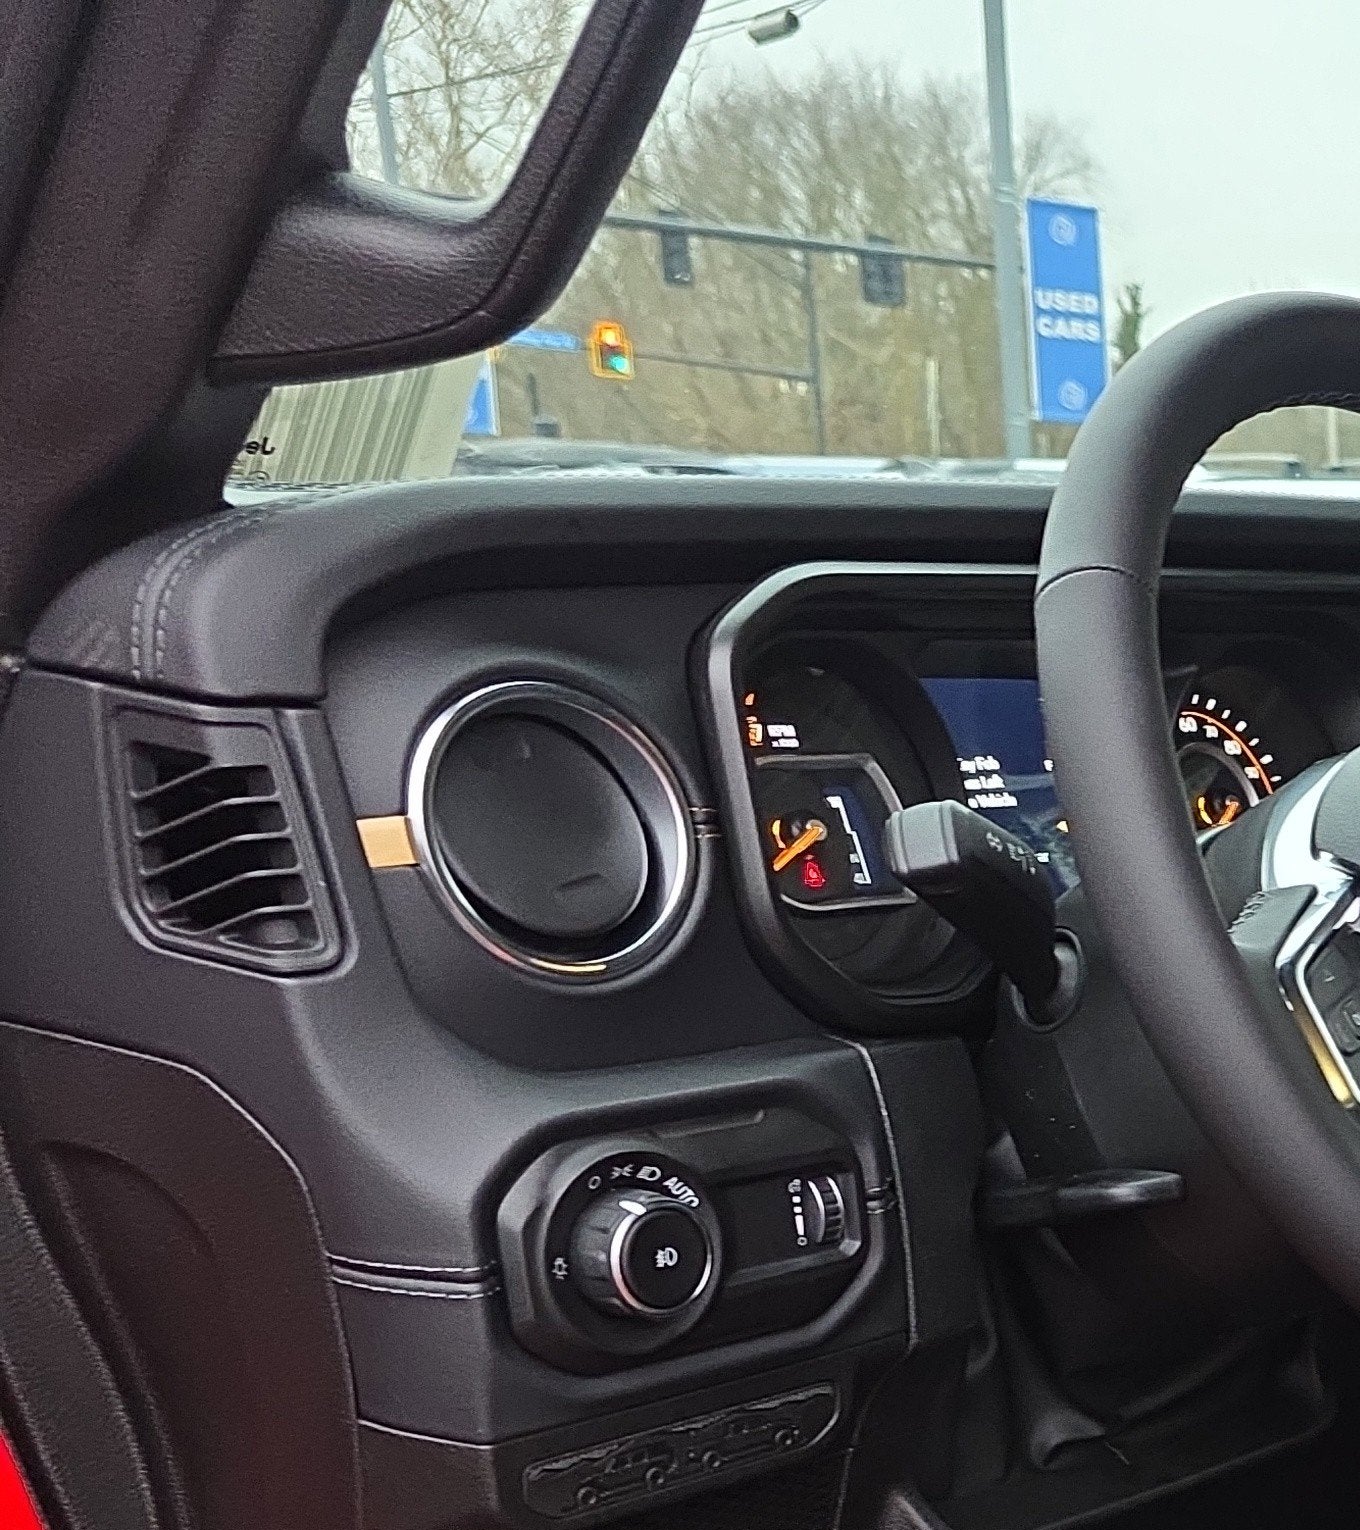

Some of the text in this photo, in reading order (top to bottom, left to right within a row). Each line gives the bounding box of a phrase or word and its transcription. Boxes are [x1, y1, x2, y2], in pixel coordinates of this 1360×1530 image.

[1034, 287, 1100, 316] USED
[1036, 316, 1100, 343] CARS
[662, 1176, 700, 1208] AUTO
